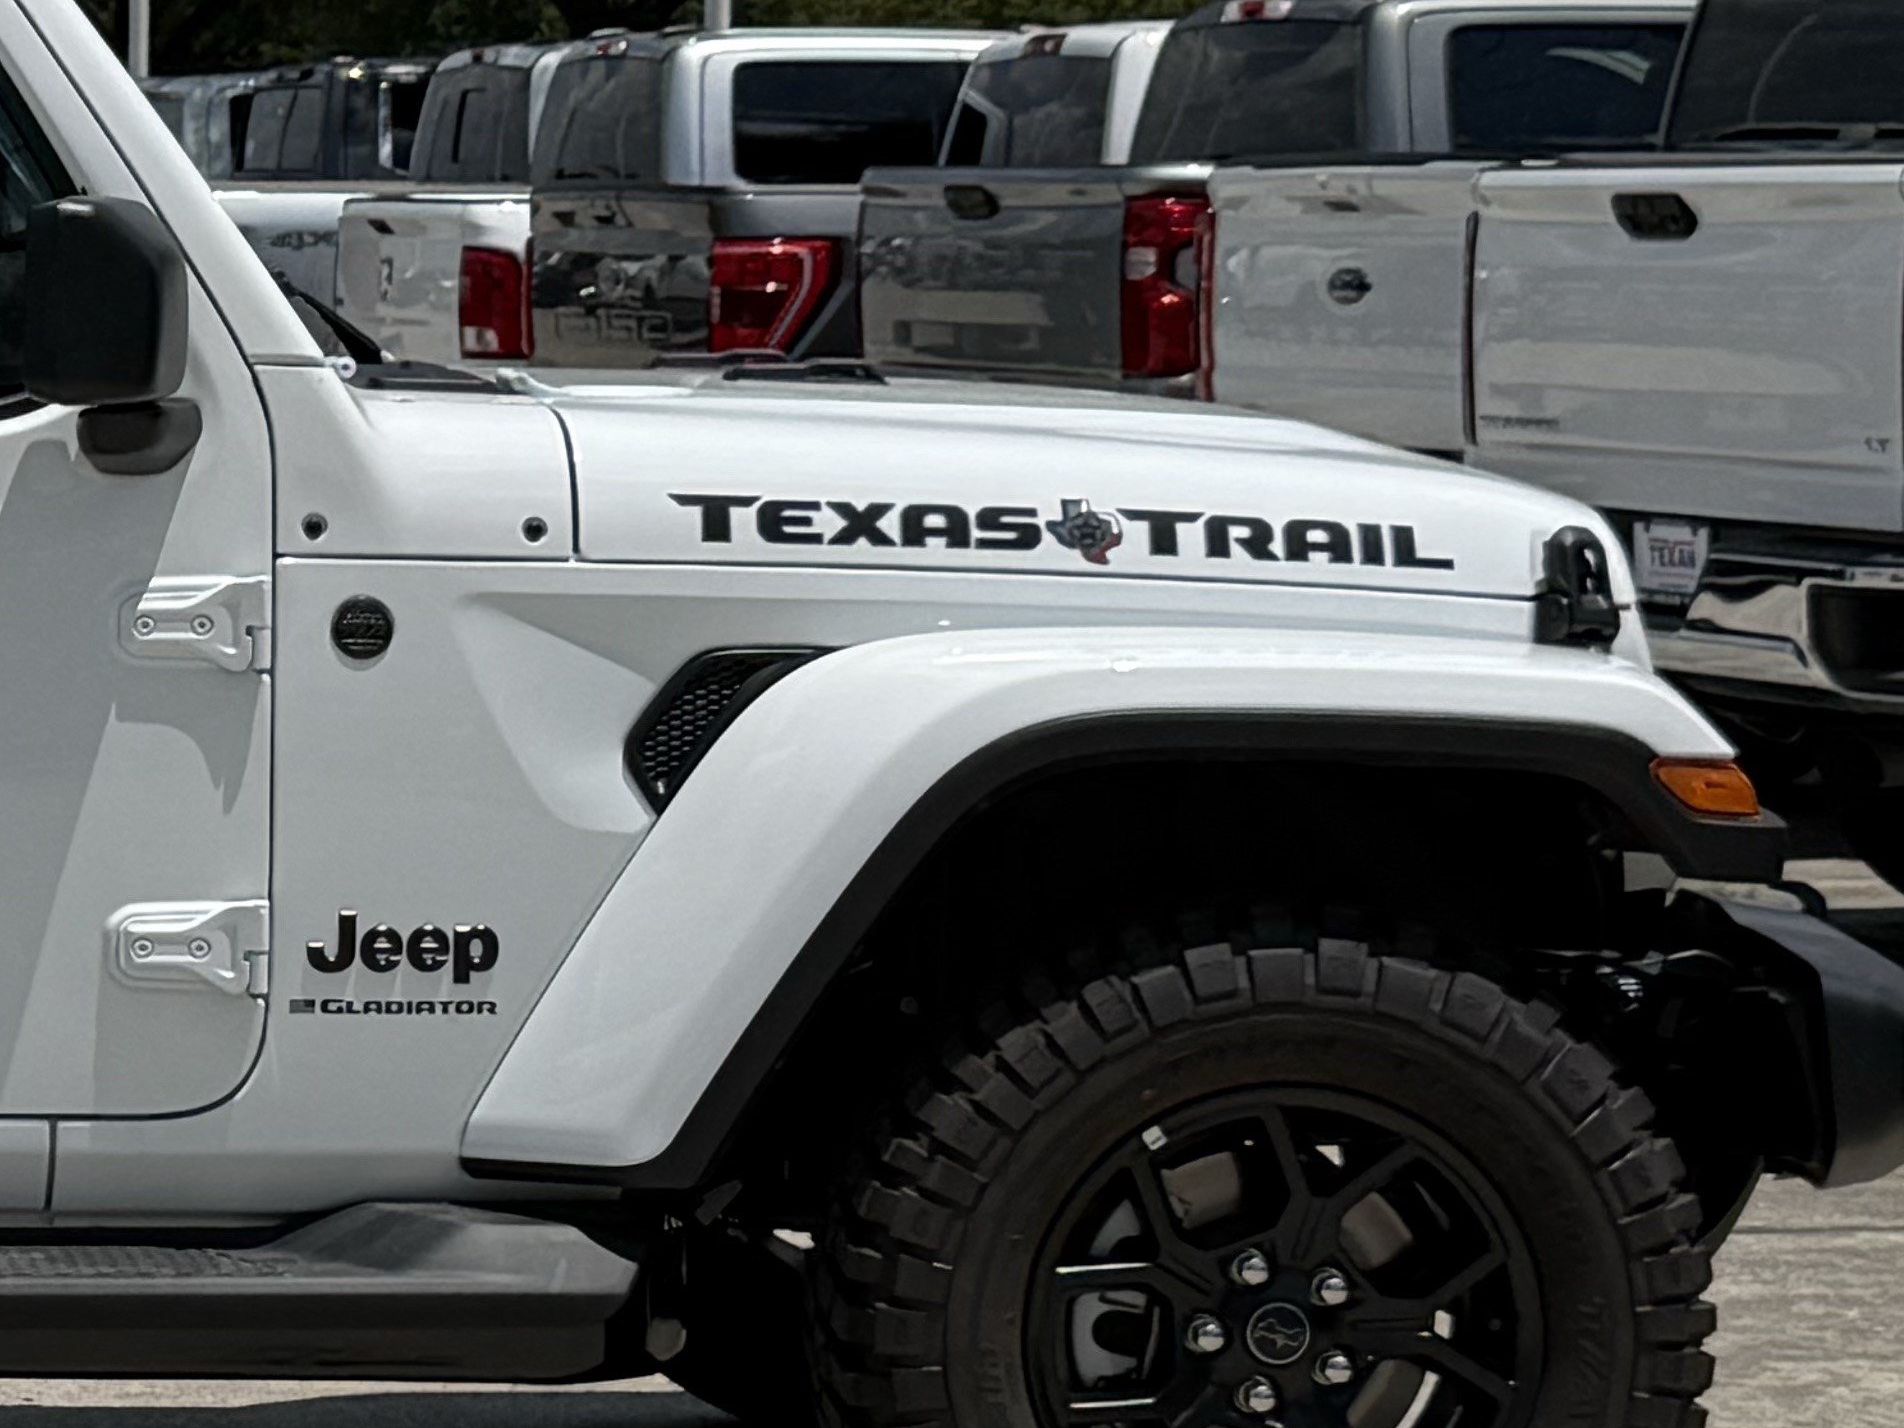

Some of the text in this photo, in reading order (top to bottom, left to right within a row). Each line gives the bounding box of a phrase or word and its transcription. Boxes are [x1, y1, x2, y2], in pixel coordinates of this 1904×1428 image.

[666, 491, 1456, 571] TEXAS TRAIL
[305, 907, 500, 985] Jeep
[319, 998, 499, 1015] GLADIATOR
